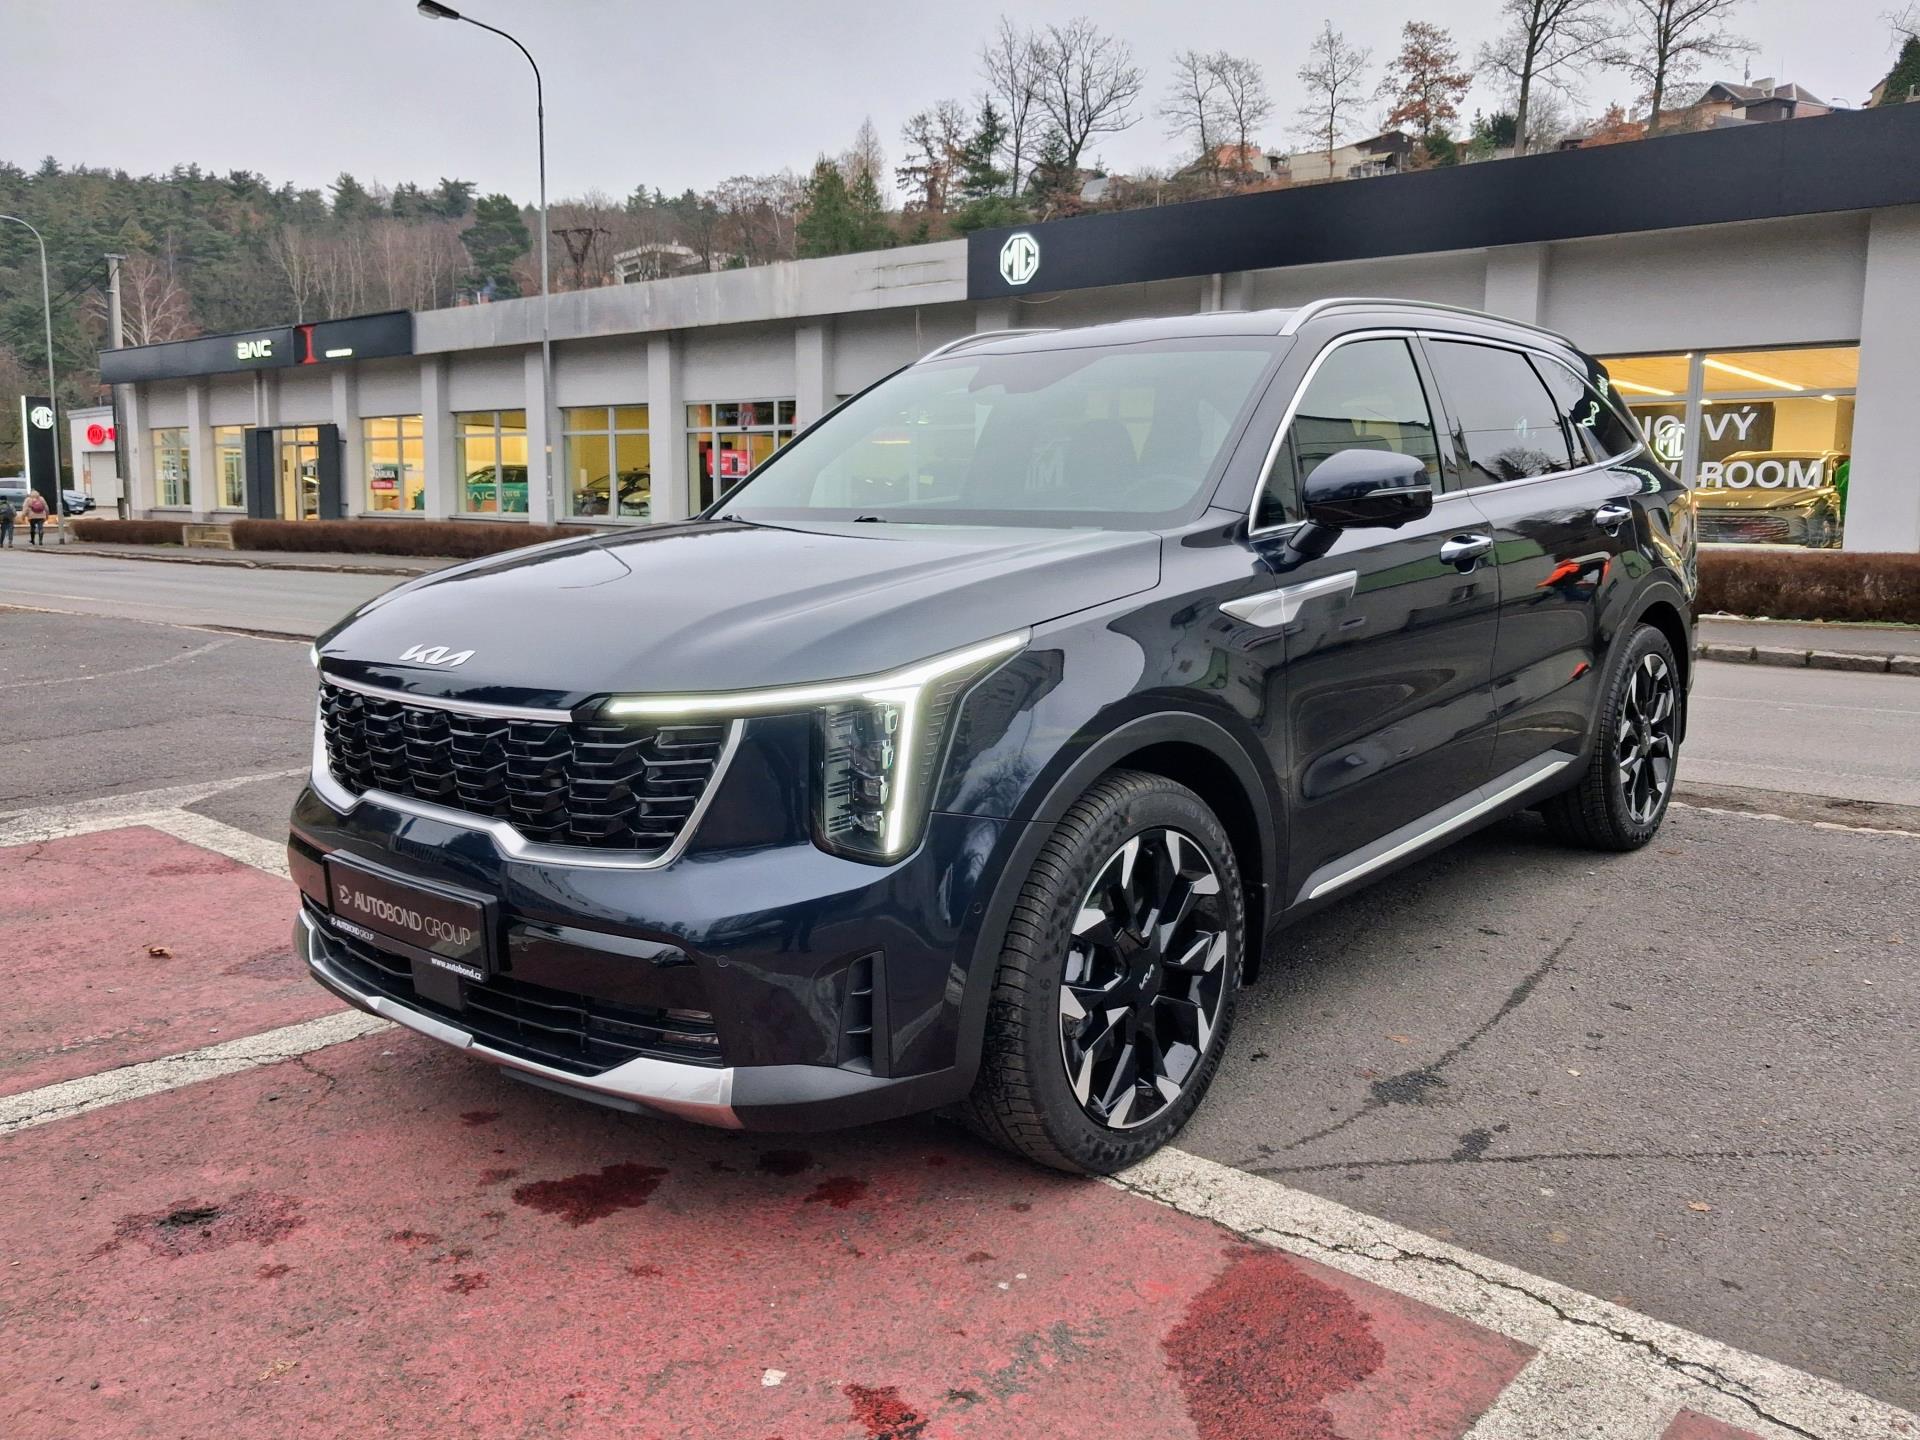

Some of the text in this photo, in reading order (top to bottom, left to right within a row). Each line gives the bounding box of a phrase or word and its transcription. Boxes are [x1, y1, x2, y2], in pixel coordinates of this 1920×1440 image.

[1002, 236, 1037, 283] MG
[32, 407, 54, 428] MG
[1700, 461, 1825, 489] ROOM
[399, 643, 476, 667] KIA
[354, 891, 471, 946] AUTOBOND GROUP
[431, 957, 482, 981] www.autobond.cz
